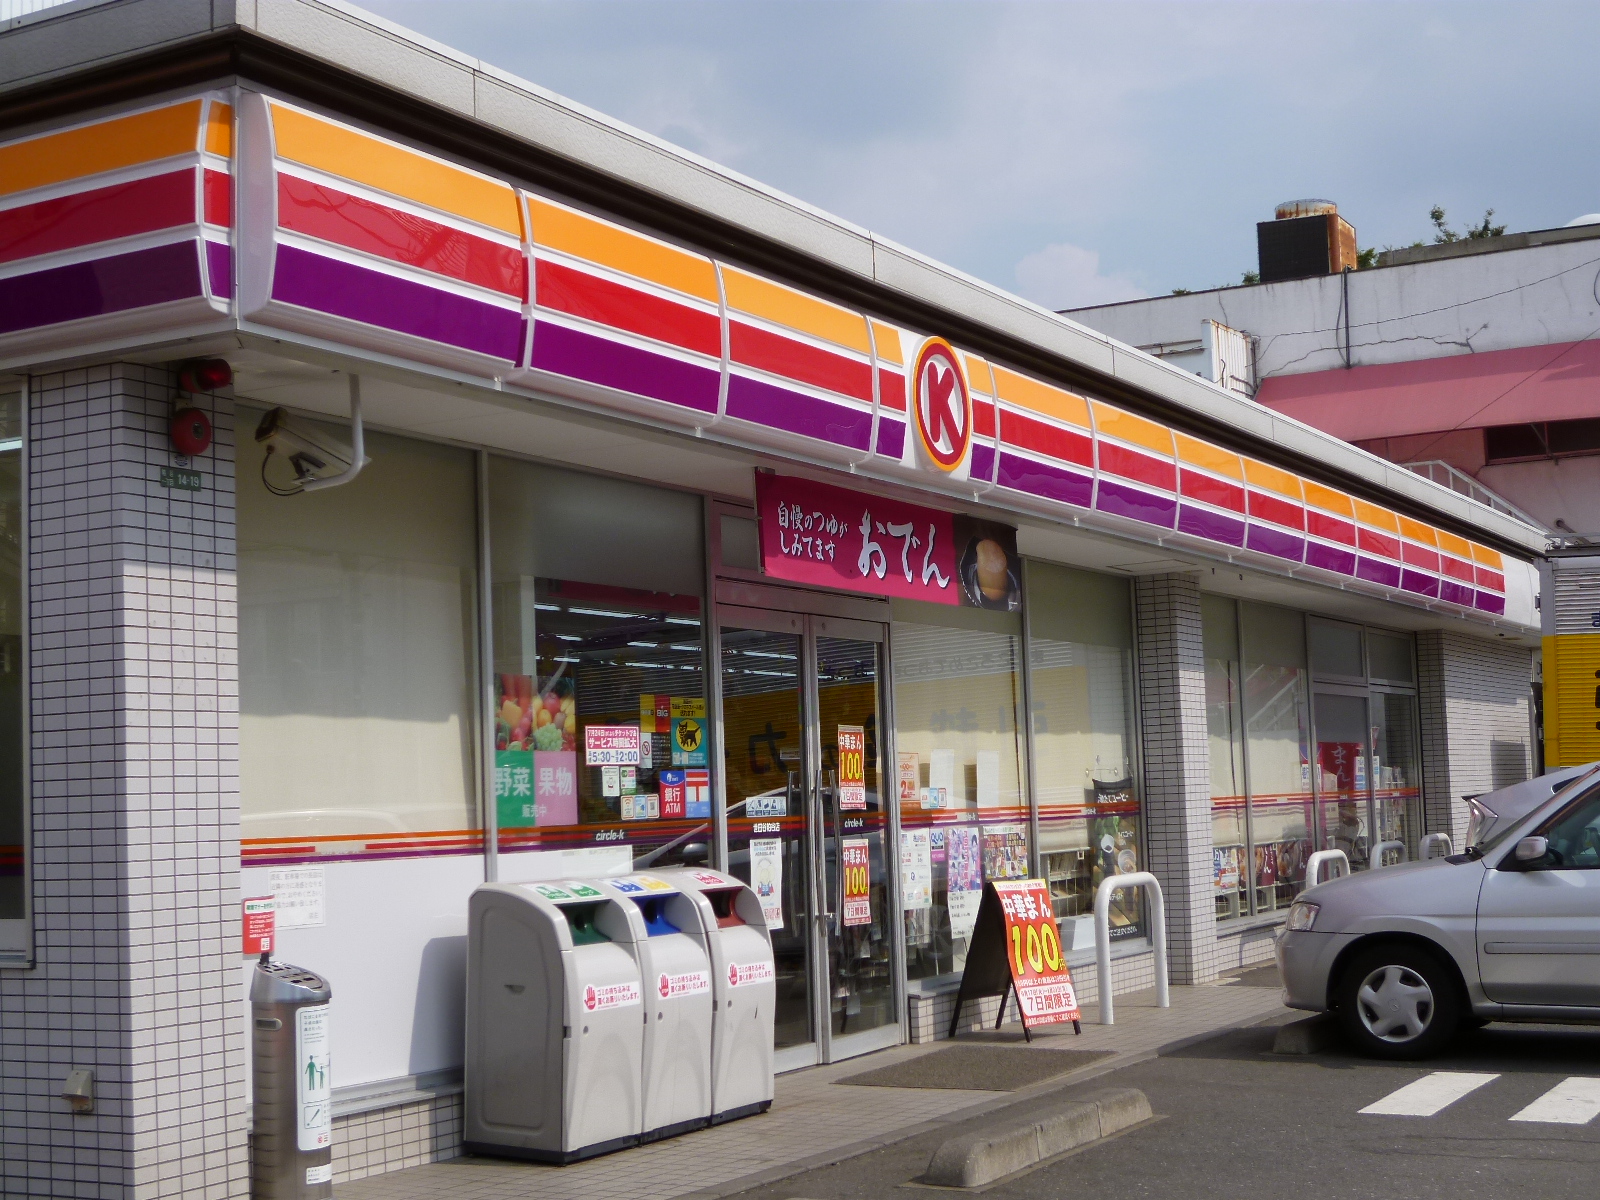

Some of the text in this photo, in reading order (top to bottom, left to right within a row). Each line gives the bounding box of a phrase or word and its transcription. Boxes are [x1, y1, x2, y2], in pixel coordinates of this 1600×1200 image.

[927, 361, 962, 453] K
[177, 474, 199, 487] 14-19
[778, 501, 848, 538] 自慢のつゆが
[779, 530, 836, 562] しみてます
[858, 508, 950, 588] おでん
[840, 733, 861, 750] 中華まん
[495, 767, 531, 797] 野菜
[539, 767, 573, 797] 果物
[664, 787, 681, 802] 銀行
[522, 804, 548, 818] 販売中
[664, 802, 681, 814] ATM
[844, 818, 864, 828] circle-k
[595, 829, 625, 841] circle-k
[843, 848, 867, 866] 中華まん
[1002, 893, 1051, 922] 中華まん
[1026, 992, 1073, 1012] 7日間限定
